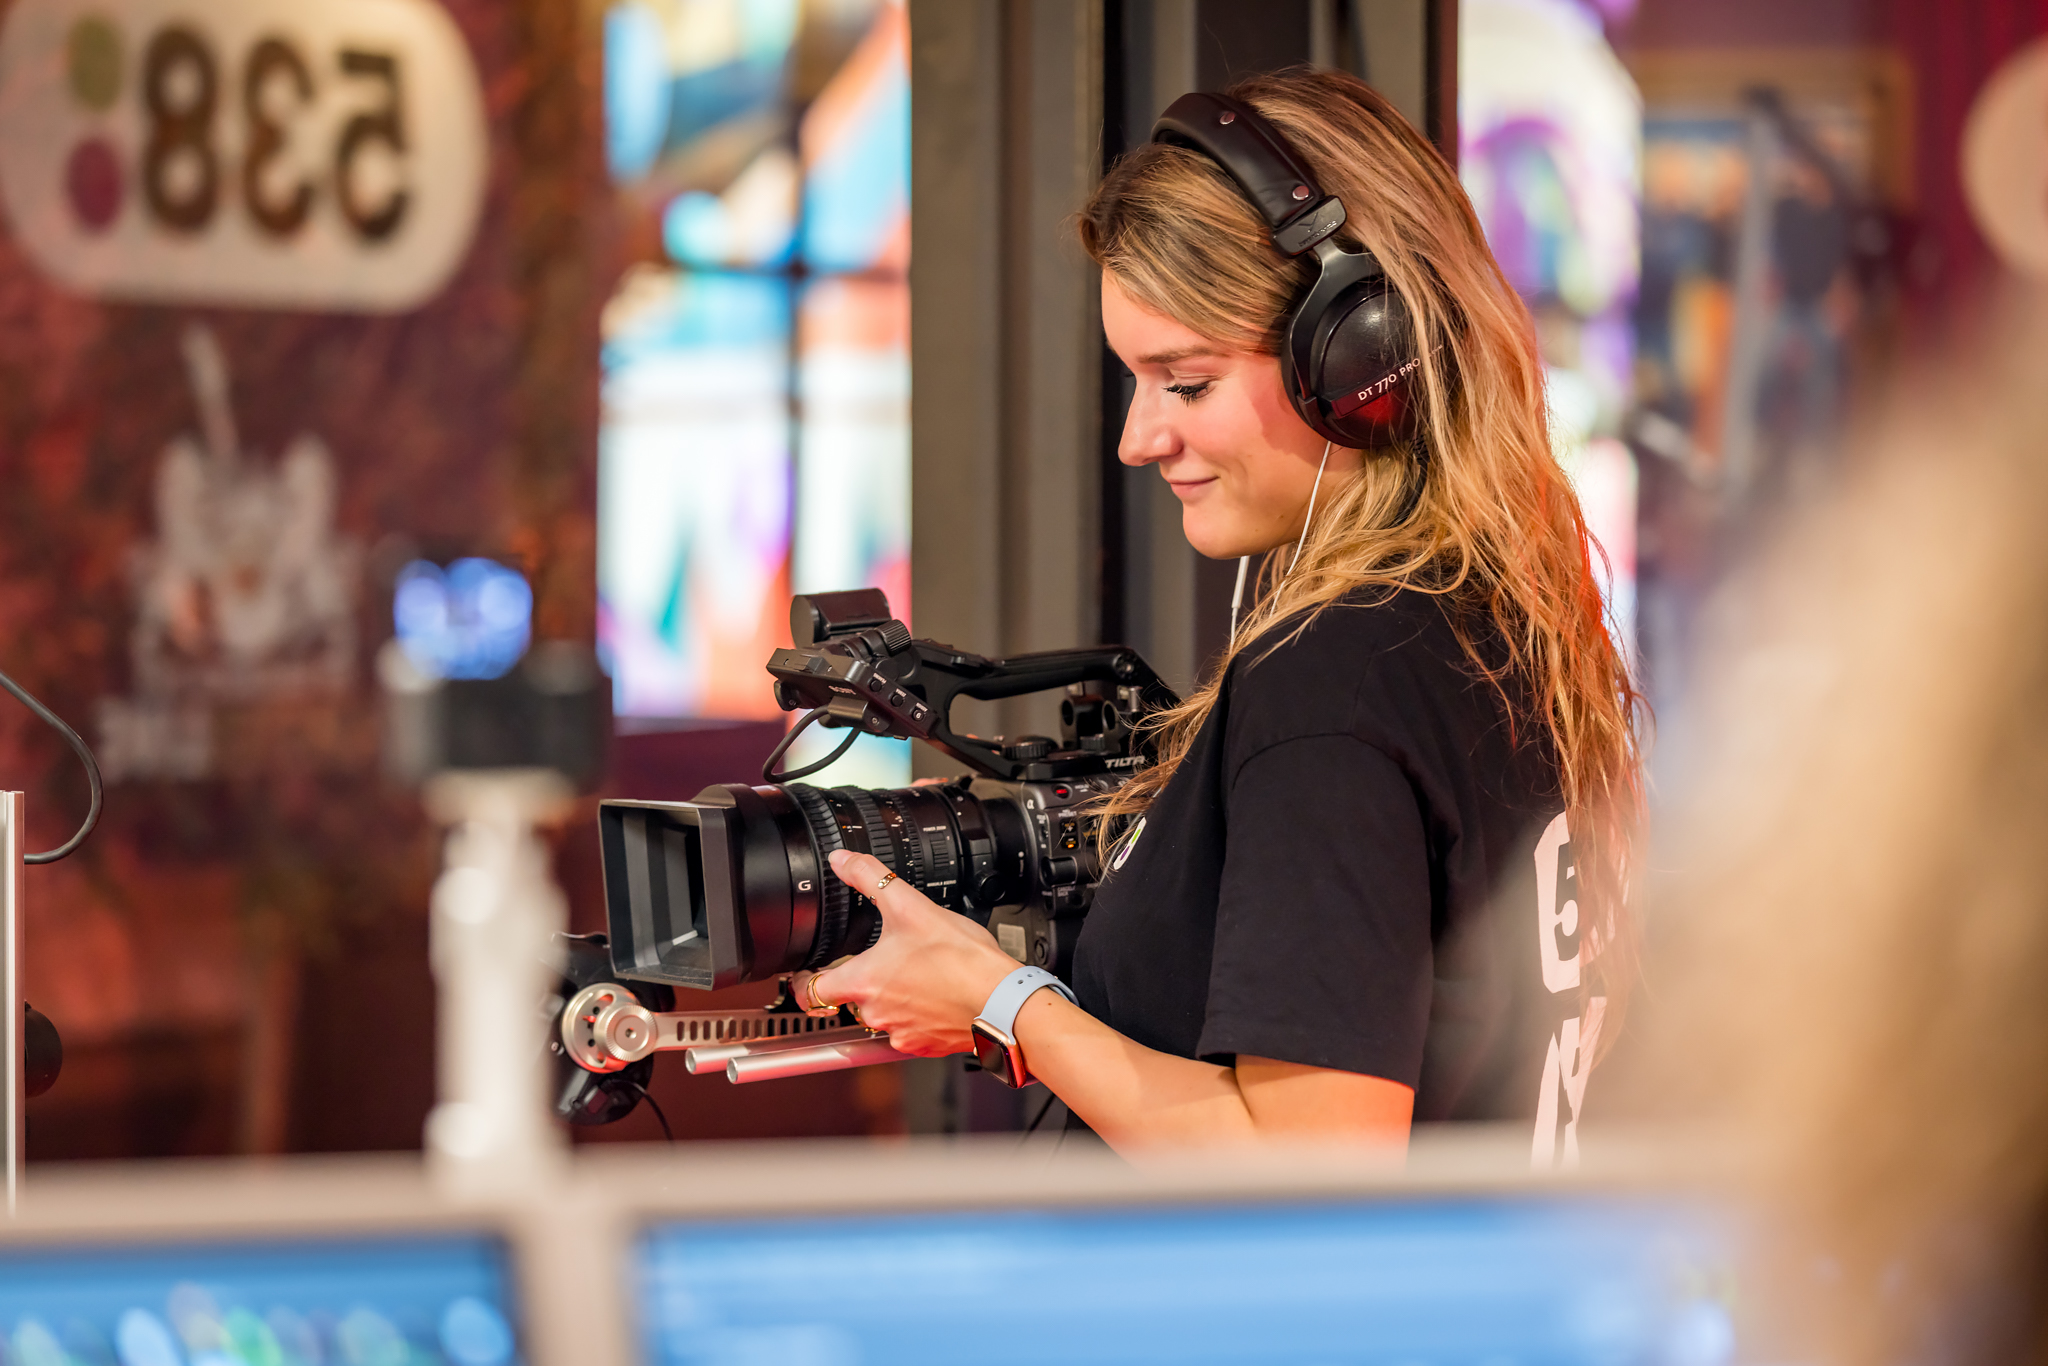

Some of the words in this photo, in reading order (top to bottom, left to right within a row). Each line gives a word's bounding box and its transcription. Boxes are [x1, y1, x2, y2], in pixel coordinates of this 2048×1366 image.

[1357, 386, 1373, 401] DT
[1374, 373, 1397, 394] 770
[1398, 358, 1421, 377] PRO
[1105, 756, 1146, 769] TILTA
[798, 880, 812, 891] G
